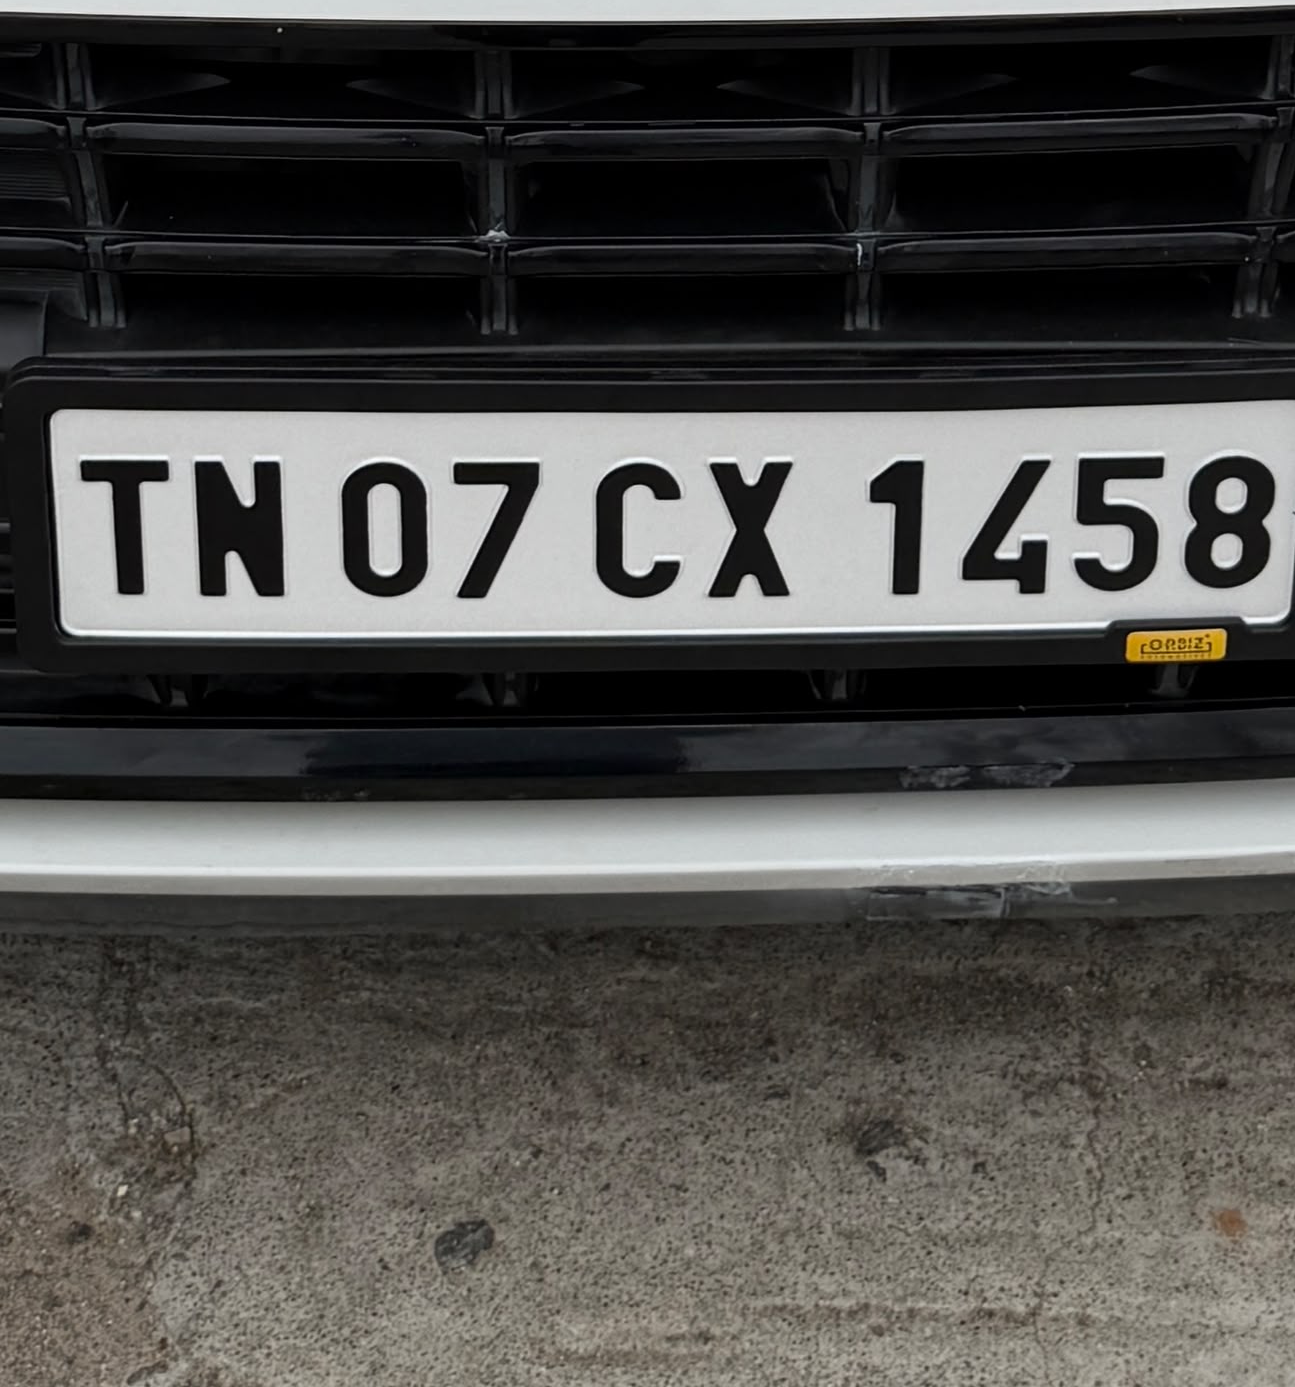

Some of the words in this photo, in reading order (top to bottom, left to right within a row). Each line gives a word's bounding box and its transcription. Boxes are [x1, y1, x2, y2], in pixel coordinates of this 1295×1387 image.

[78, 458, 286, 598] TN
[340, 461, 541, 599] 07
[594, 460, 794, 599] CX
[868, 455, 1277, 596] 1458
